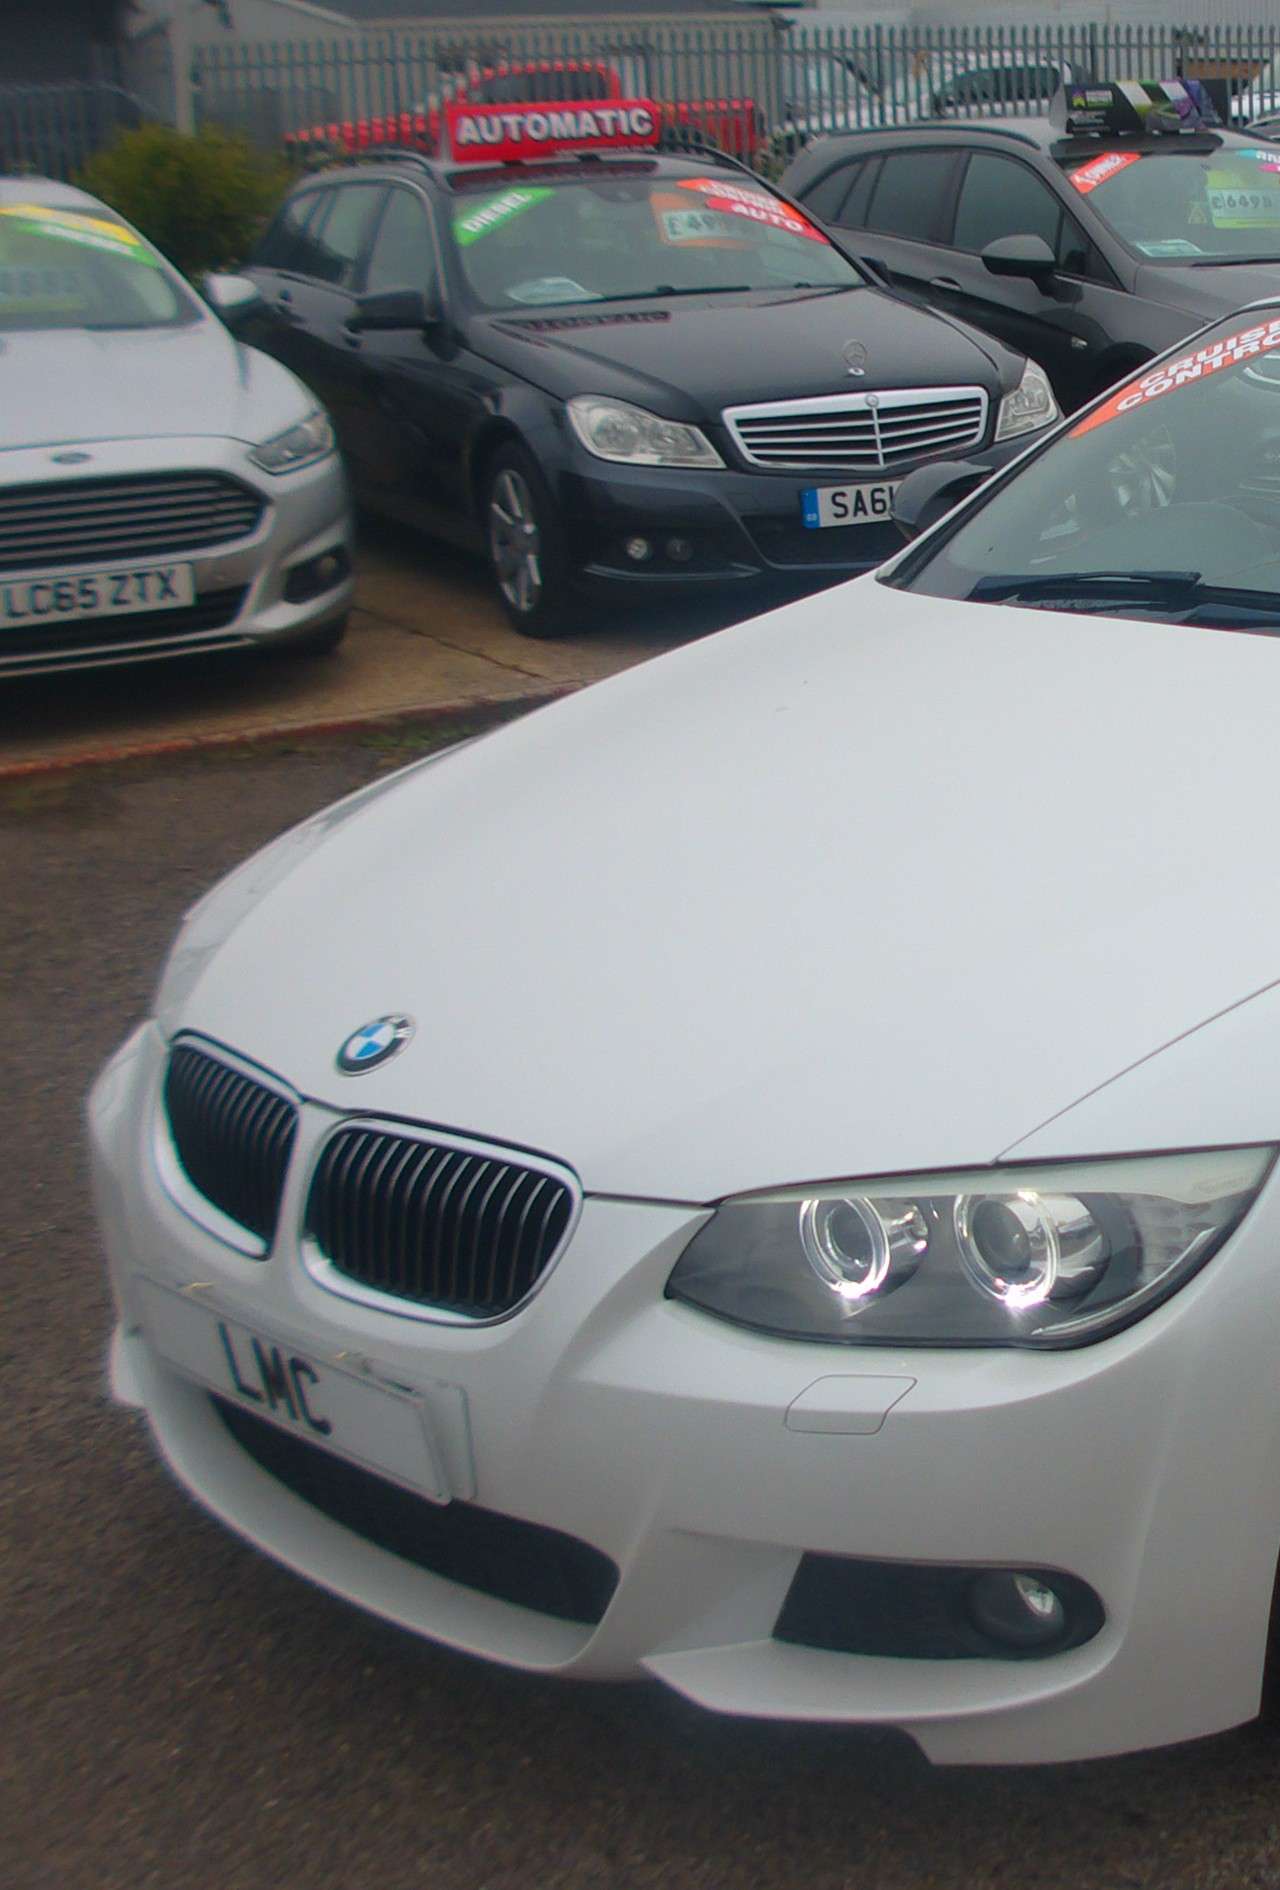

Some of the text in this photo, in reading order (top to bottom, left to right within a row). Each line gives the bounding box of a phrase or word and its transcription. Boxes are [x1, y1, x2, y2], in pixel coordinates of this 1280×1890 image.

[457, 108, 653, 145] AUTOMATIC
[4, 568, 177, 618] LC65 ZTX
